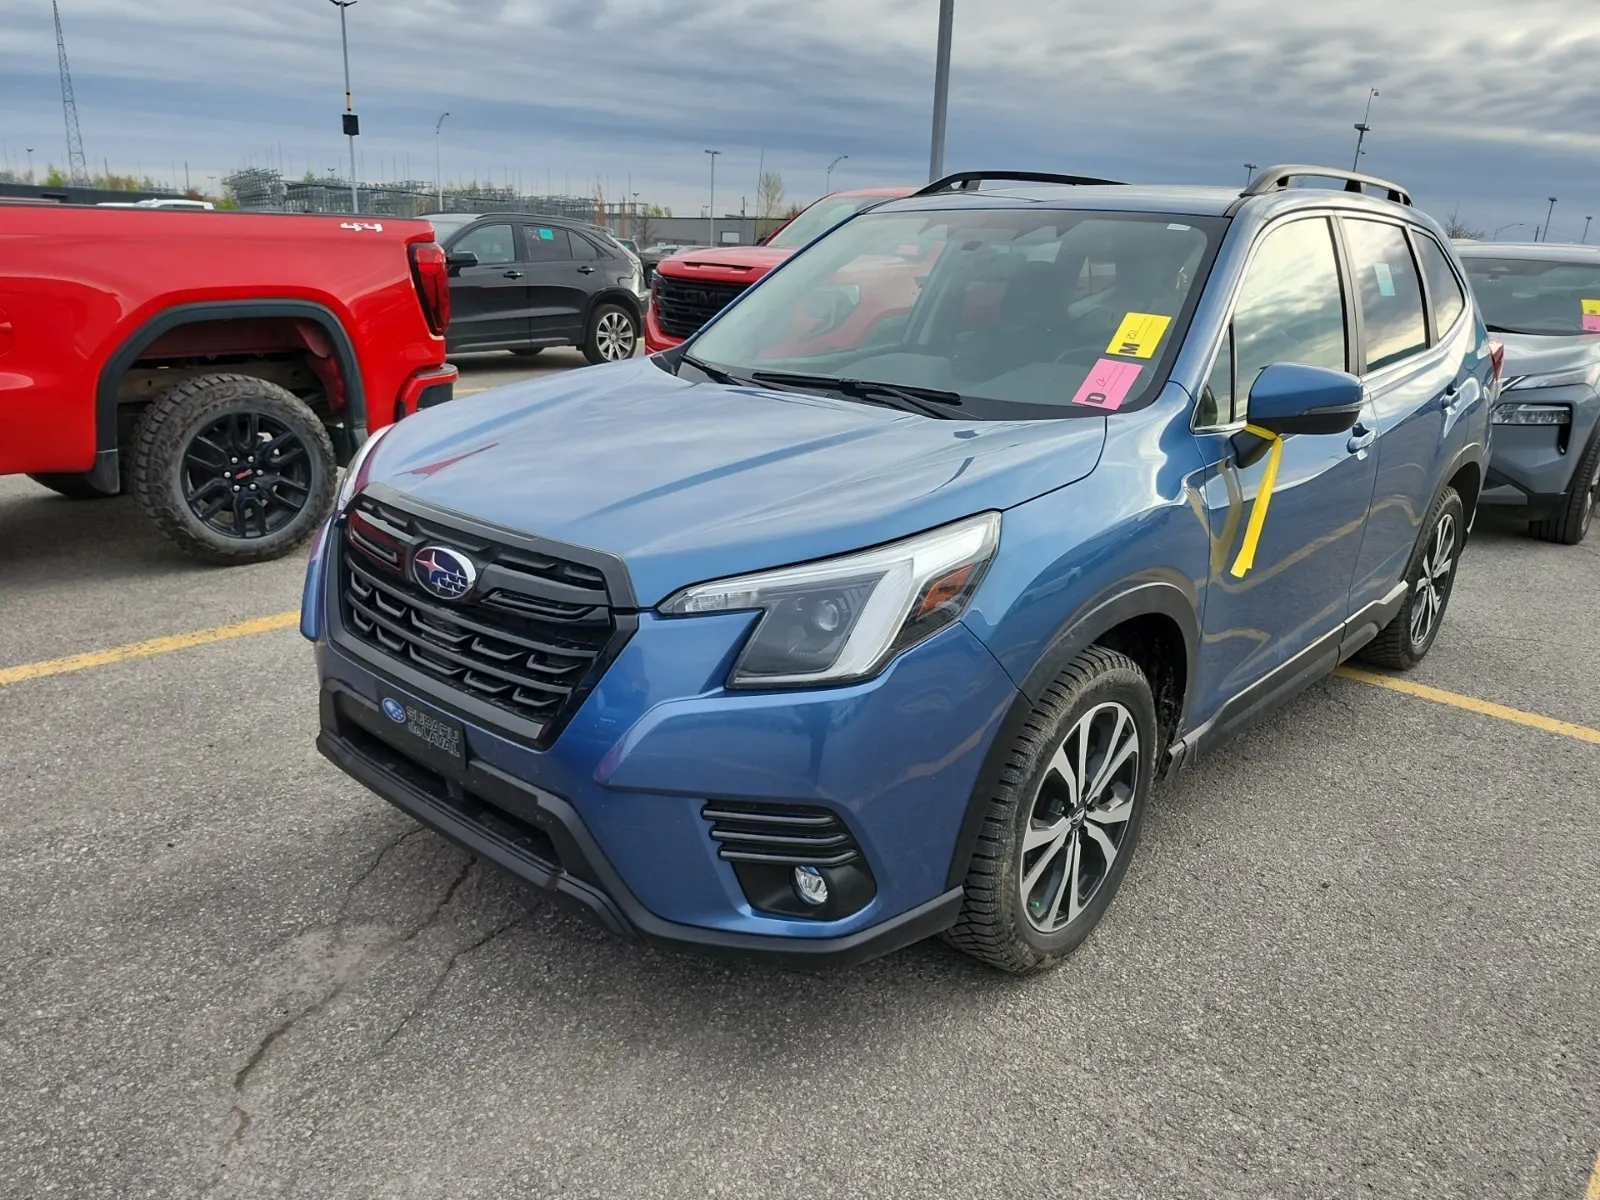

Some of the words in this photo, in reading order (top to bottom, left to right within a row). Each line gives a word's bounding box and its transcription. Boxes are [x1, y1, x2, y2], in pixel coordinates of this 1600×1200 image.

[1118, 342, 1140, 355] M
[1085, 392, 1107, 405] D
[406, 705, 459, 743] SUBARU
